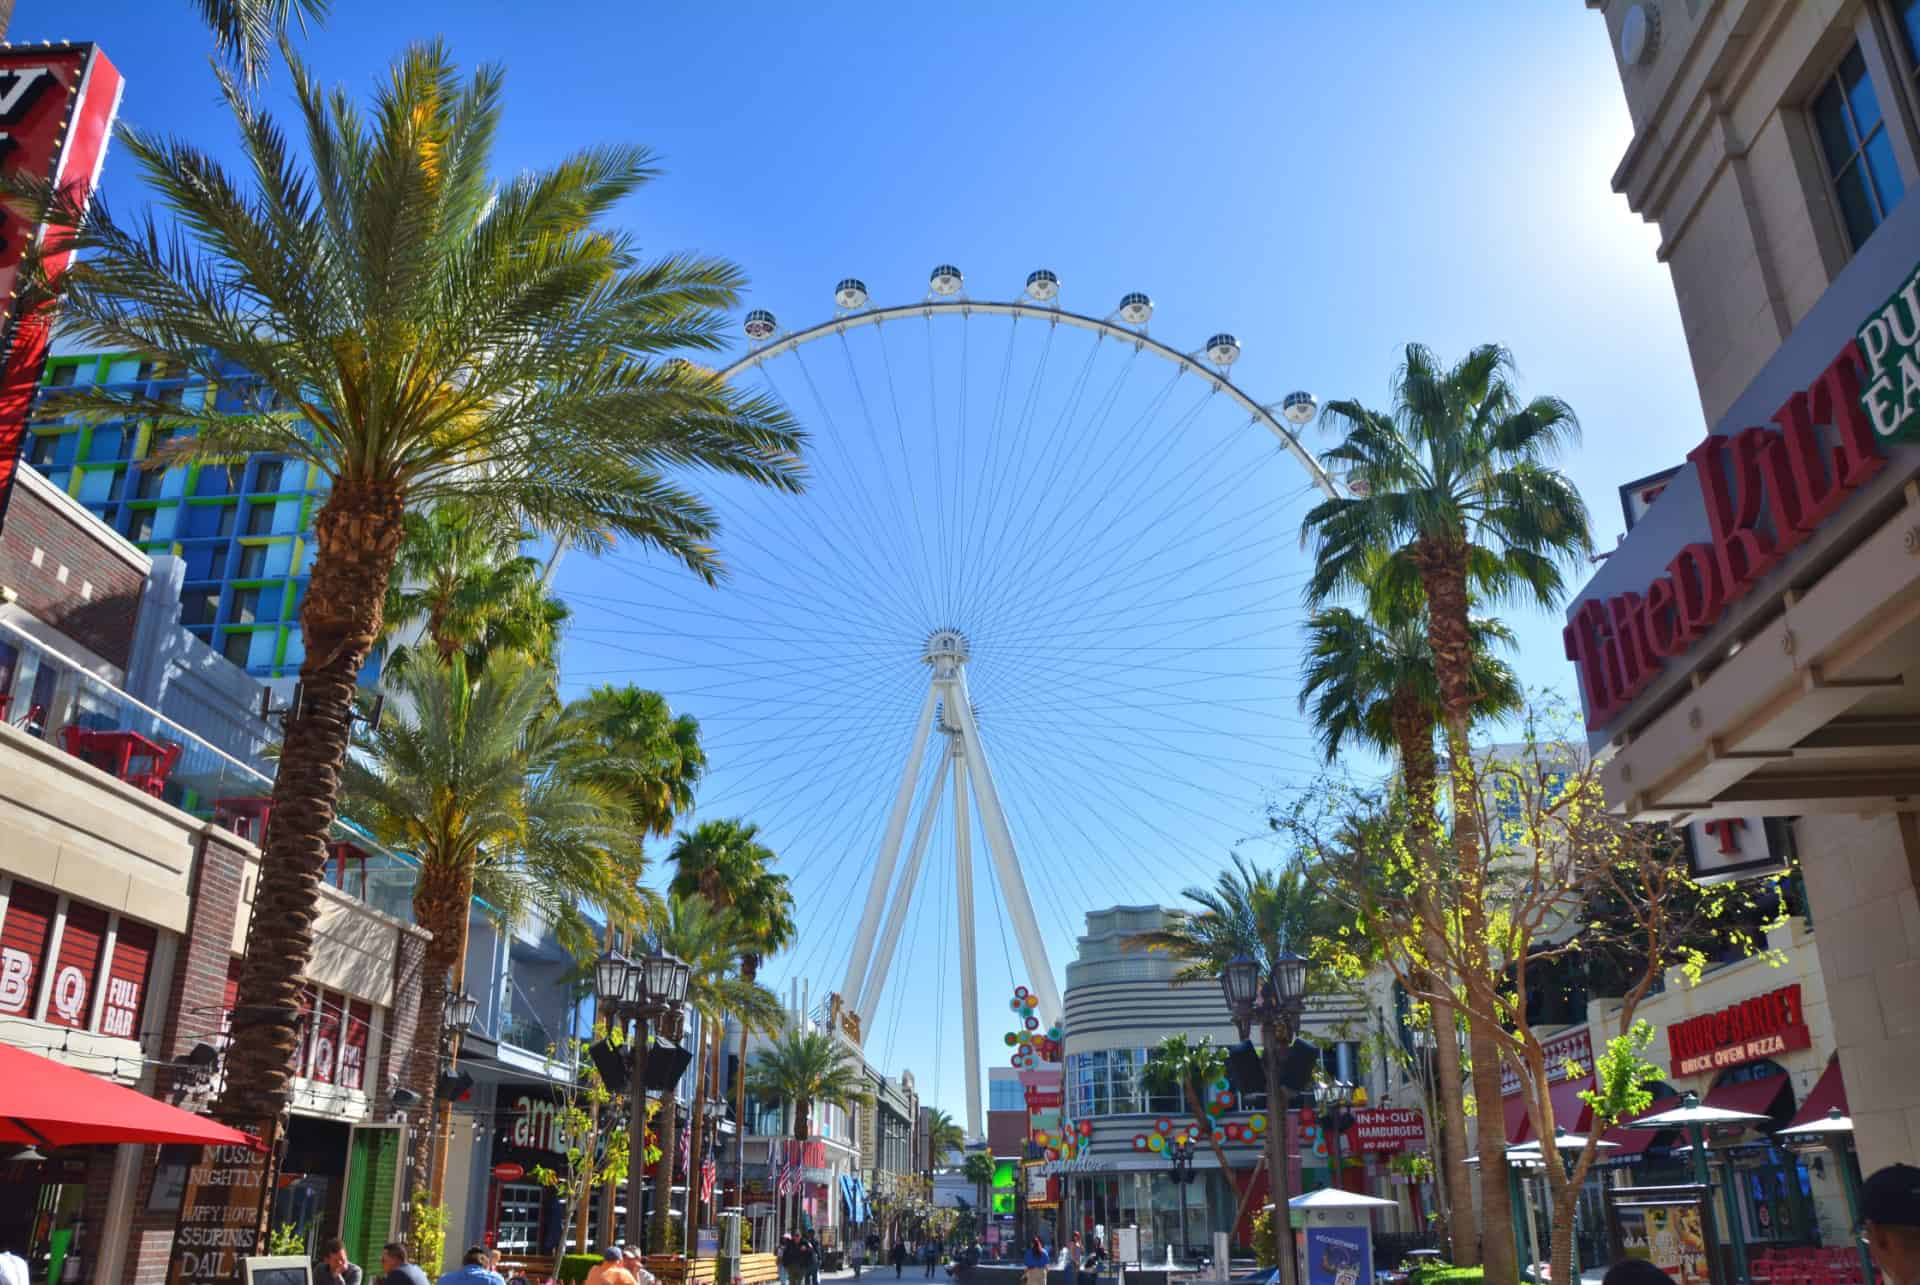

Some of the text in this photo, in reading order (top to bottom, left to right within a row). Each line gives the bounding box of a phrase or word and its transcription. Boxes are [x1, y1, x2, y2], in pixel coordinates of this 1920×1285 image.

[1858, 271, 1920, 382] PU
[1861, 345, 1920, 436] EA
[108, 977, 139, 1009] FULL
[103, 1005, 134, 1037] BAR
[1728, 984, 1804, 1043] BARLEY
[1681, 1036, 1785, 1075] BRICK OVEN PIZZA
[1356, 1112, 1416, 1124] IN-N-OUT
[1358, 1126, 1424, 1138] HAMBURGERS
[189, 1167, 264, 1187] NIGHTLY
